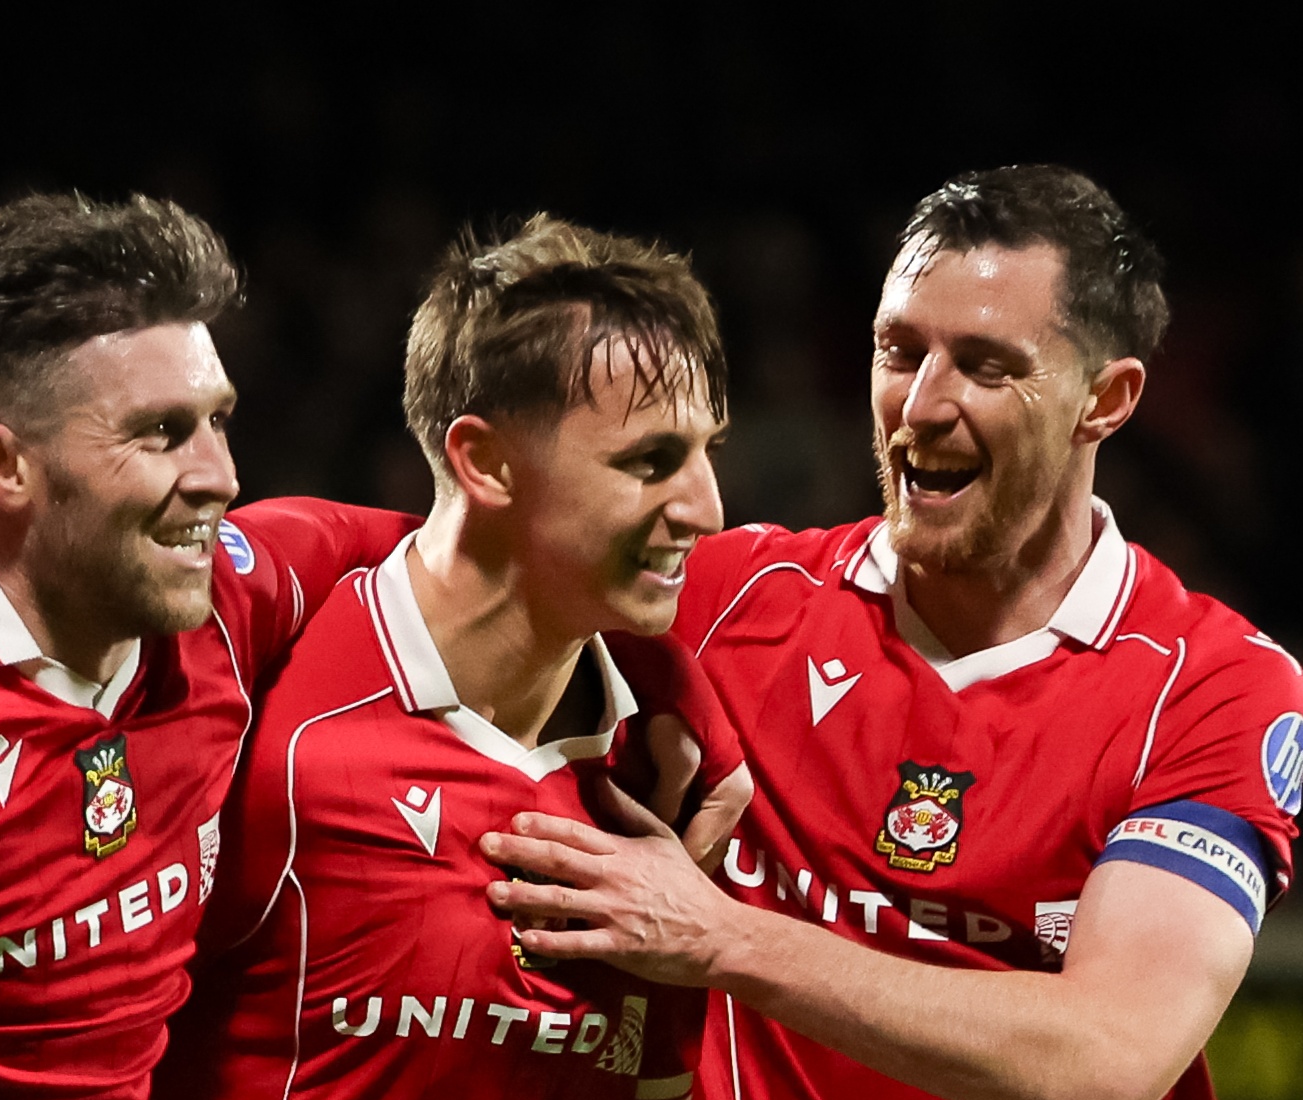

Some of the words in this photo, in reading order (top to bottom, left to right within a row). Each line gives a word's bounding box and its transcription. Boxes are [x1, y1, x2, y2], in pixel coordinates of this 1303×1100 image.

[723, 838, 1012, 943] UNITED
[1123, 820, 1168, 839] EFL
[1176, 830, 1263, 898] CAPTAIN
[332, 996, 608, 1054] UNITED
